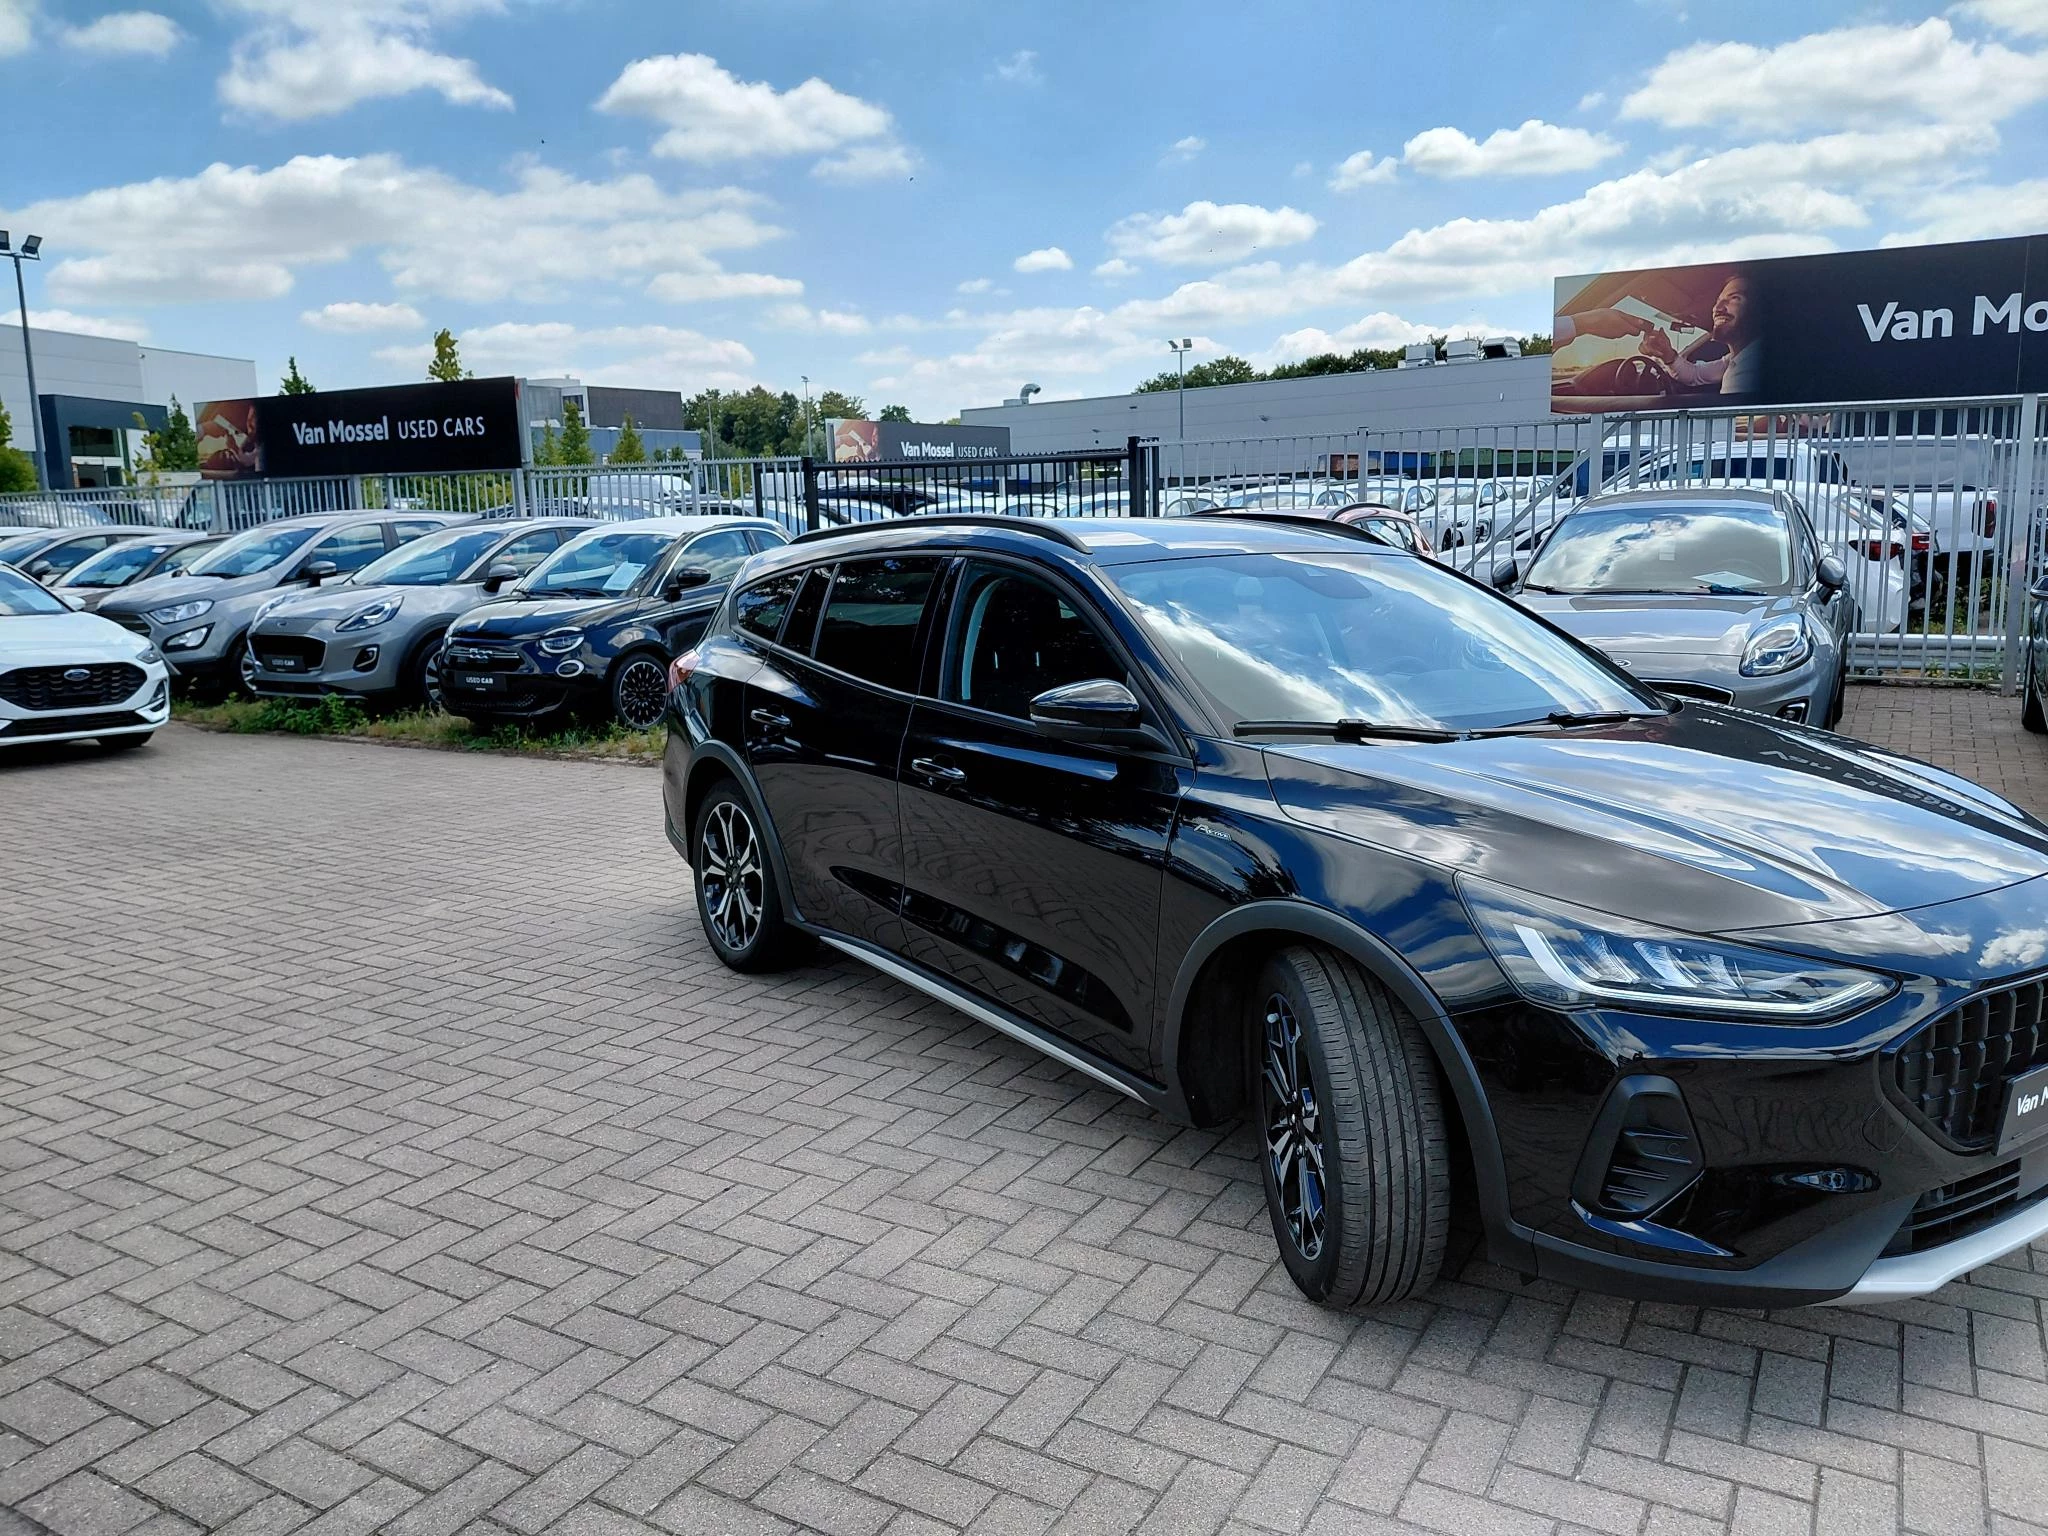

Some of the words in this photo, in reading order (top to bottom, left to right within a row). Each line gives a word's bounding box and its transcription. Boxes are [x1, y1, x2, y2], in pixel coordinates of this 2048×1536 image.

[1856, 301, 1954, 342] Van
[1972, 292, 2048, 336] Mo
[292, 421, 326, 445] Van
[328, 415, 390, 443] Mossel
[398, 419, 438, 440] USED
[443, 416, 485, 437] CARS
[900, 441, 921, 457] Van
[921, 442, 954, 458] Mossel
[957, 446, 978, 458] USED
[979, 446, 998, 458] CARS
[2017, 1094, 2039, 1116] Van
